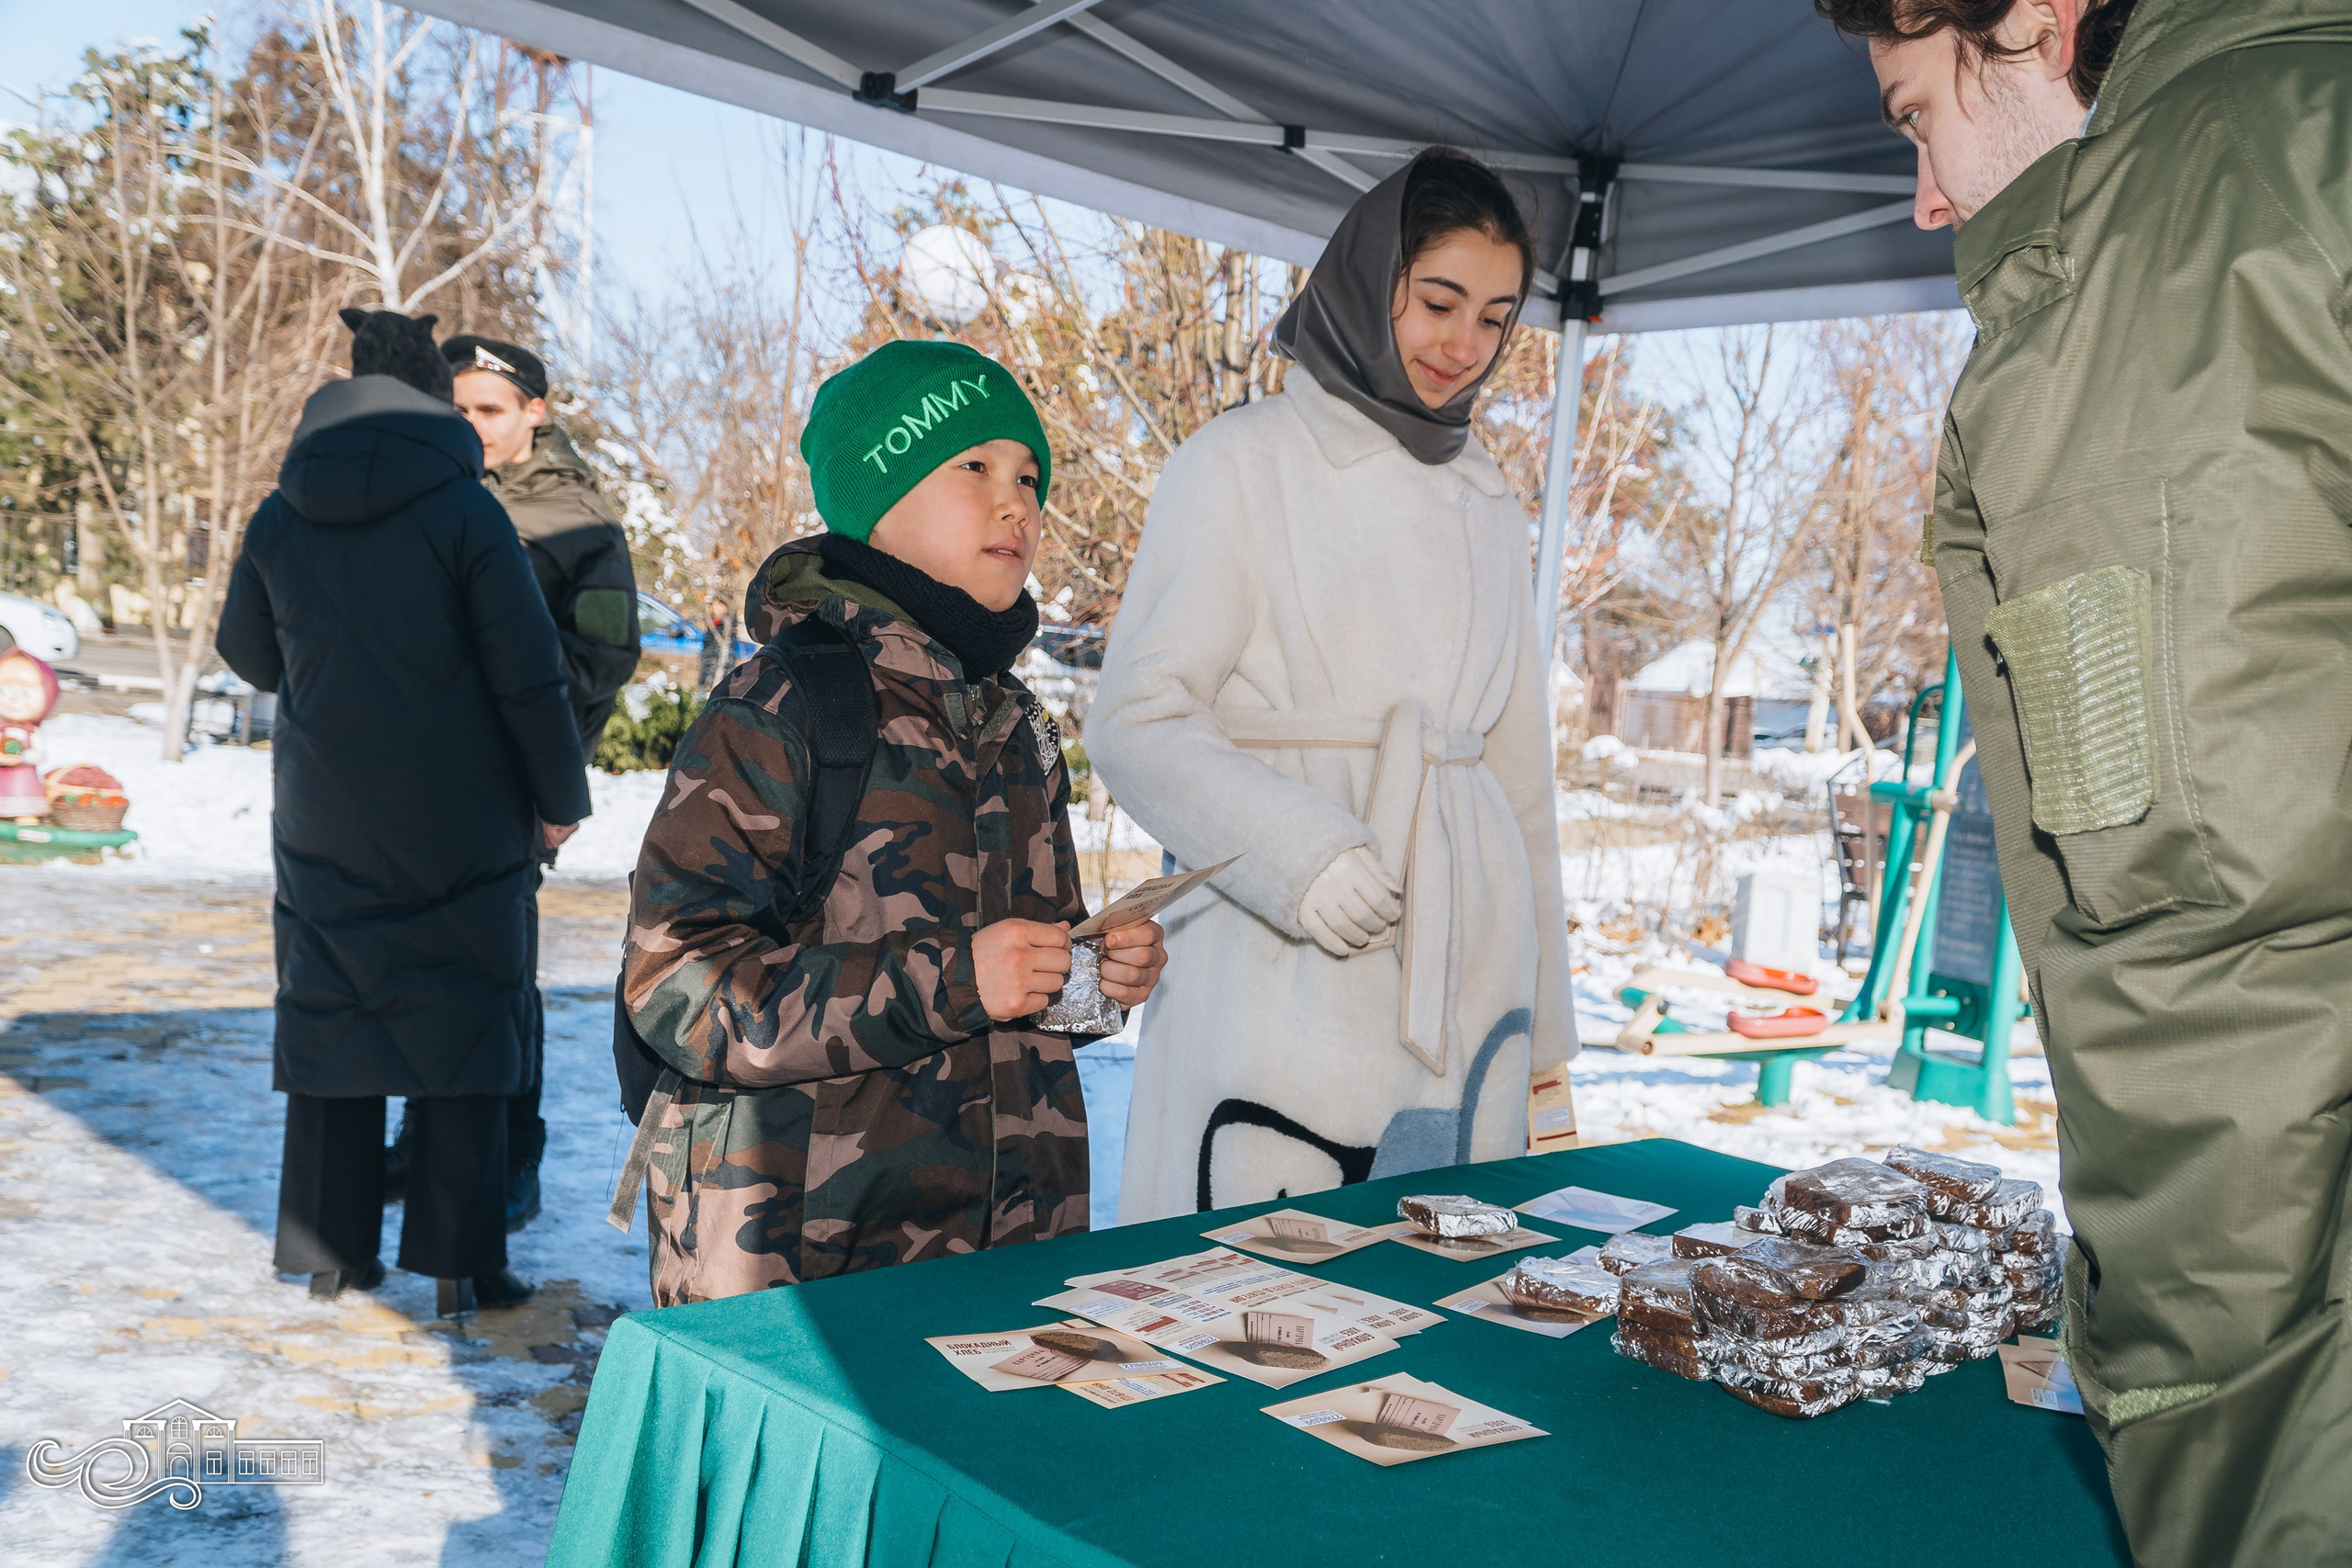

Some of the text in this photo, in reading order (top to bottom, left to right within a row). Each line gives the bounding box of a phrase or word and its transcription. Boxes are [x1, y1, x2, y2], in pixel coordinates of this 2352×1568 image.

[862, 374, 990, 474] TOMMY
[1339, 1326, 1363, 1337] ХЛЕБ
[946, 1338, 1012, 1350] БЛОКАДНЫЙ
[1329, 1332, 1375, 1352] БЛОКАДНЫЙ
[954, 1348, 982, 1357] ХЛЕБ
